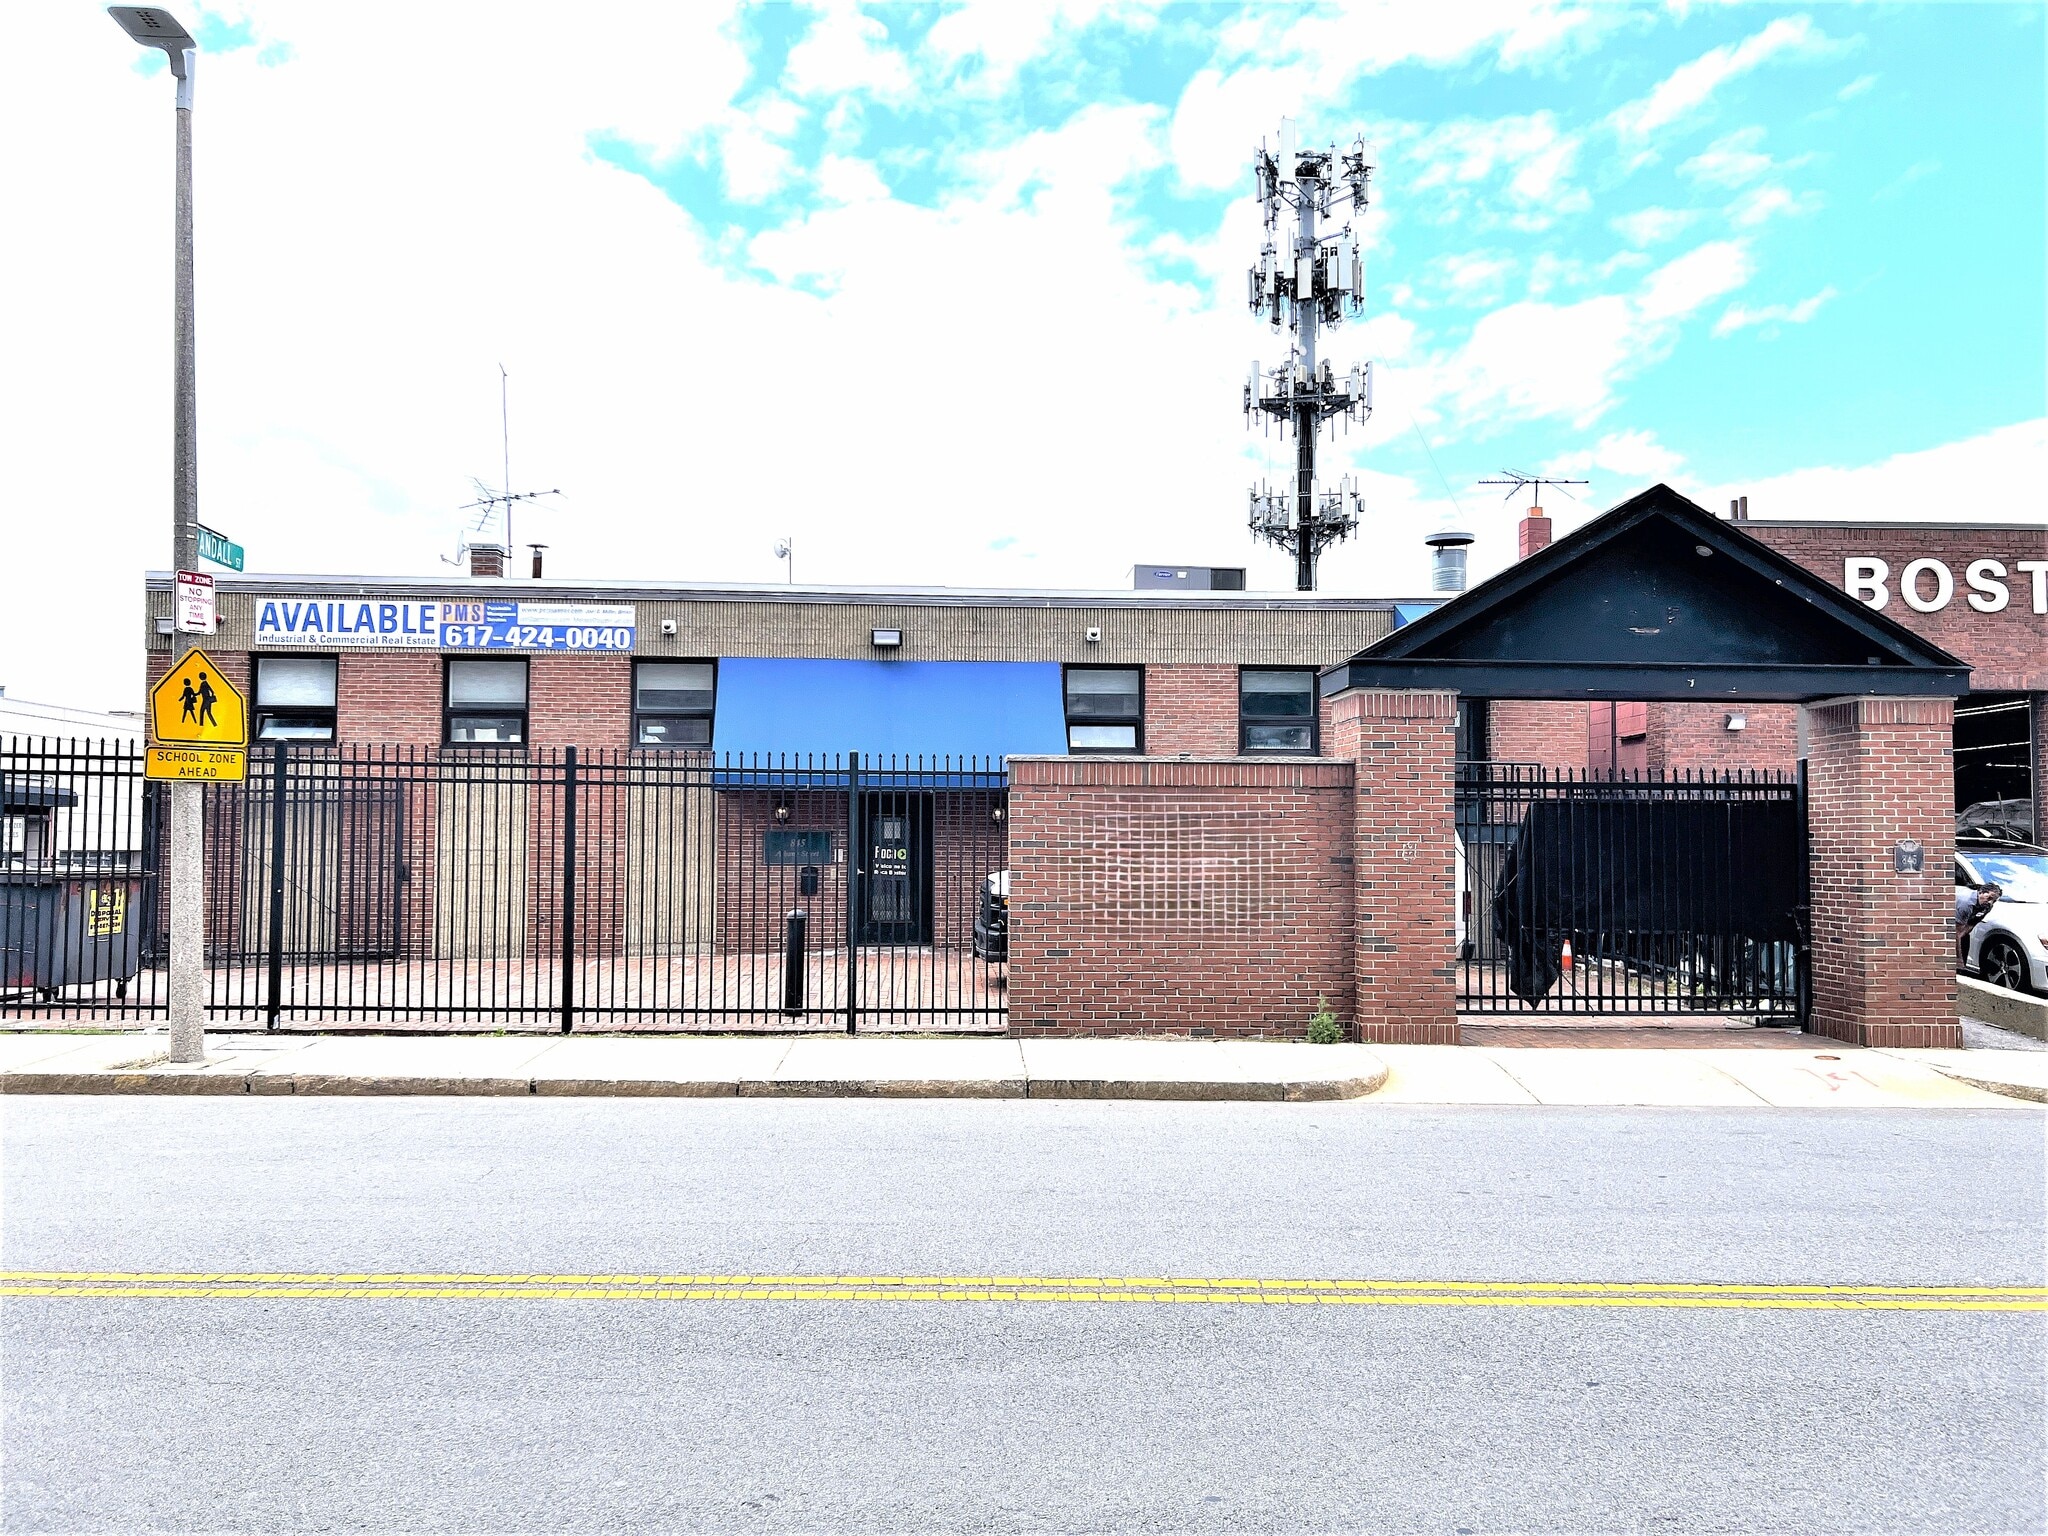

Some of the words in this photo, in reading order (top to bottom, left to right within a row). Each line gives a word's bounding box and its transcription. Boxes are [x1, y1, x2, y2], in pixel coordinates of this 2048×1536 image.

[198, 532, 233, 566] ANDALL
[178, 573, 193, 582] TOW
[195, 575, 213, 585] ZONE
[188, 587, 203, 597] NO
[179, 595, 213, 606] STOPPING
[188, 611, 205, 620] TIME
[258, 602, 435, 634] AVAILABLE
[442, 604, 481, 622] PMS
[259, 633, 306, 643] Industrial
[309, 635, 317, 644] &
[320, 634, 378, 645] Commercial
[382, 635, 403, 645] Real
[406, 636, 436, 645] Estate
[445, 625, 631, 649] 617-424-0040
[157, 752, 203, 763] SCHOOL
[209, 753, 236, 764] ZONE
[178, 767, 217, 777] AHEAD
